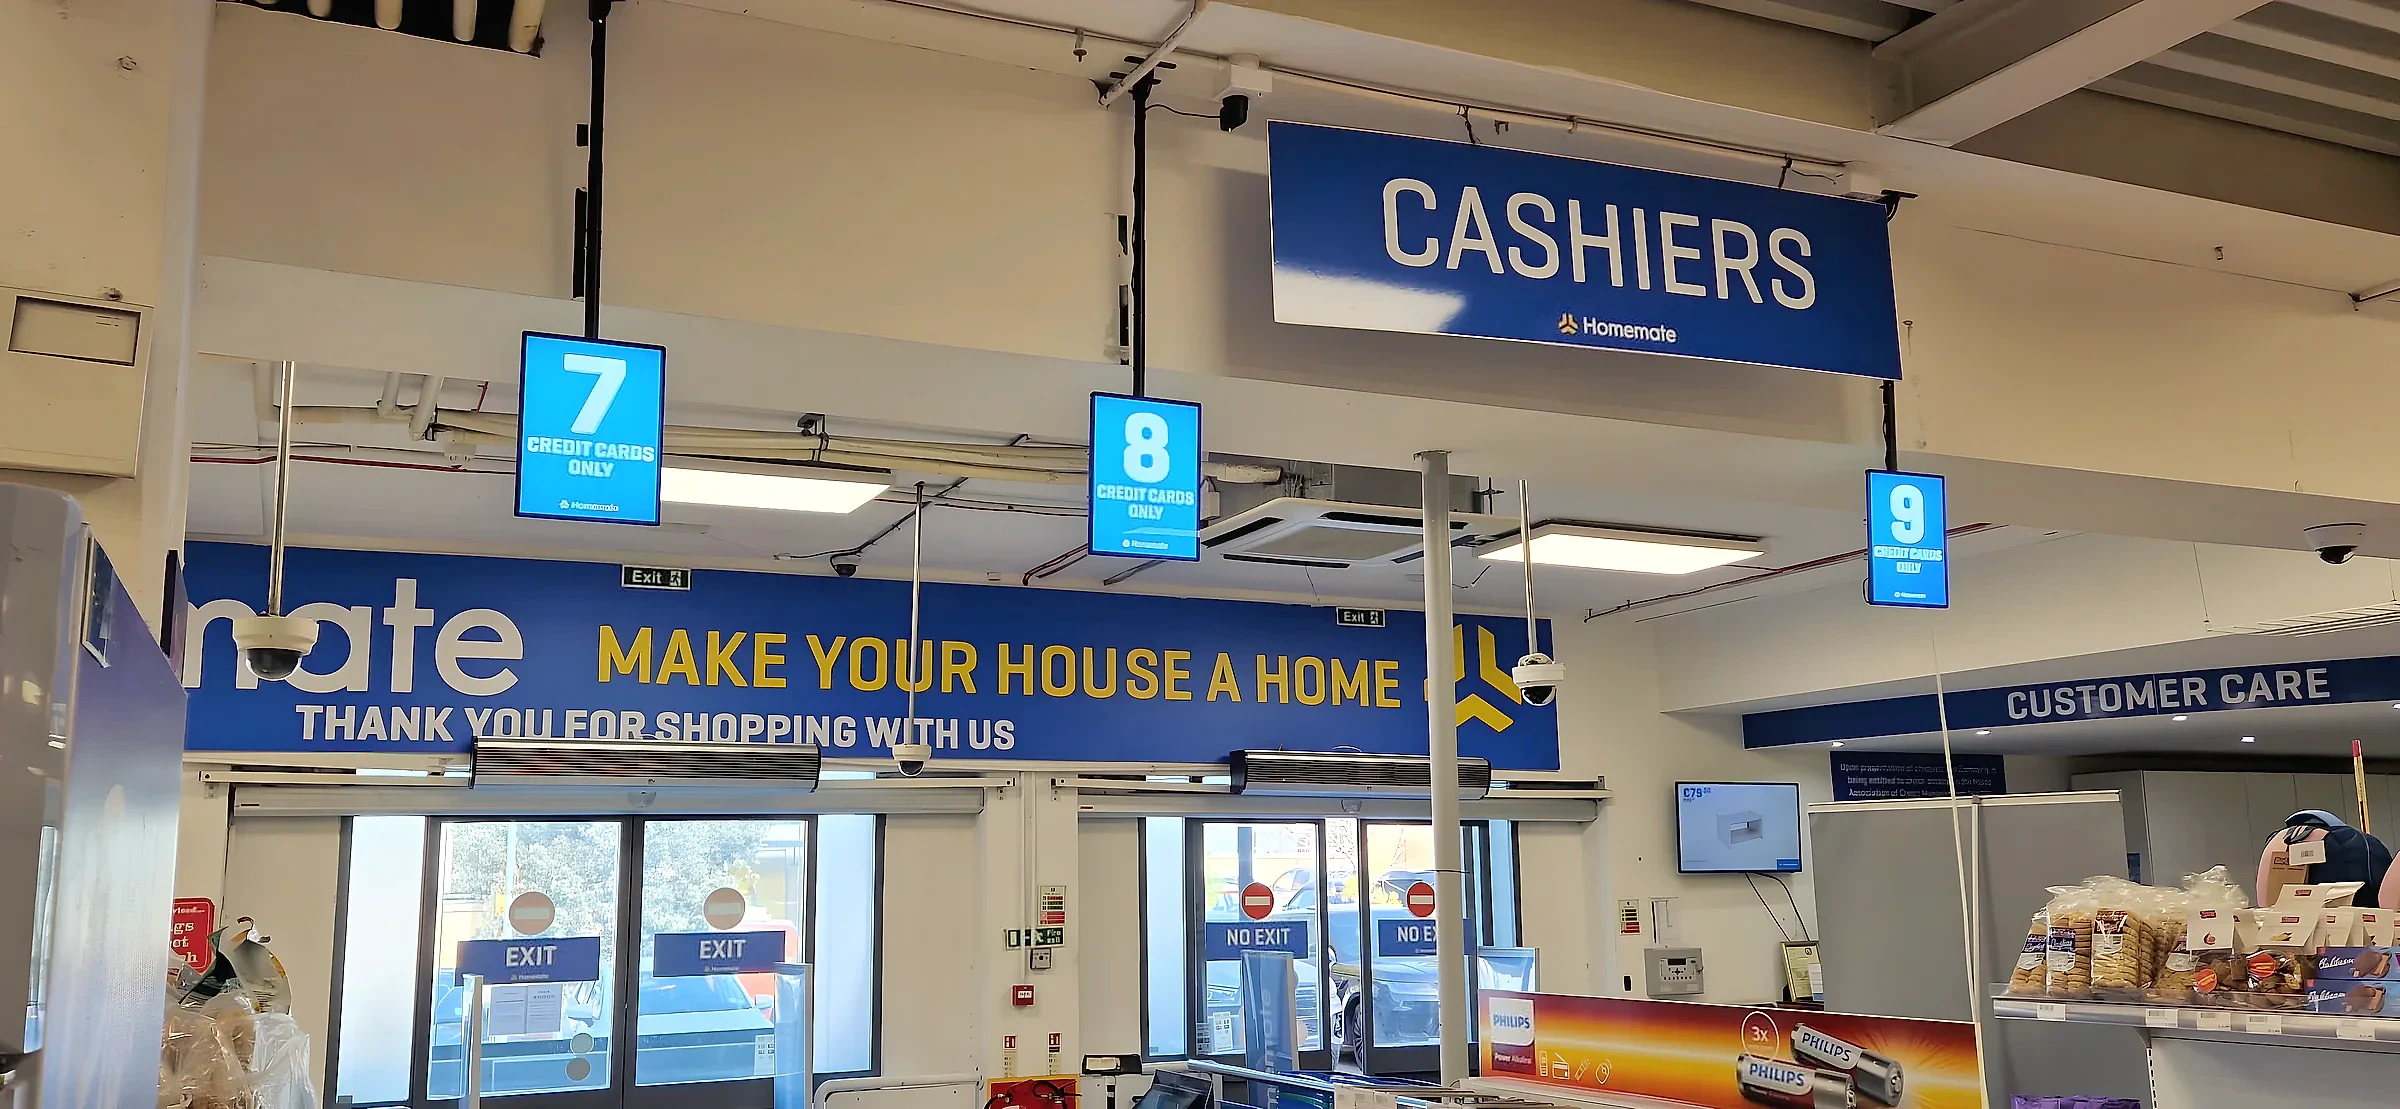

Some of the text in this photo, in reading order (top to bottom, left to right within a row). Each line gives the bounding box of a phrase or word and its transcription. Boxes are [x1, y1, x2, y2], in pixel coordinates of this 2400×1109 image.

[1381, 177, 1817, 310] CASHIERS
[1583, 315, 1677, 344] Homemate
[563, 353, 627, 435] 7
[527, 436, 655, 462] CREDIT CARDS
[1123, 412, 1170, 484] 8
[568, 459, 615, 479] ONLY
[1096, 484, 1195, 506] CREDIT CARDS
[1128, 503, 1164, 521] ONLY
[1889, 484, 1925, 545] 9
[632, 569, 662, 585] Exit
[598, 625, 1401, 708] MAKE YOUR HOUSE A HOME
[2007, 667, 2331, 720] CUSTOMER CARE
[296, 704, 1015, 751] THANK YOU FOR SHOPPING WITH US
[1227, 928, 1290, 946] NO EXIT
[1397, 926, 1419, 942] NO
[506, 945, 557, 967] EXIT
[700, 939, 746, 959] EXIT
[1493, 1012, 1531, 1029] PHILIPS
[1752, 1025, 1768, 1042] 3x
[1801, 1032, 1851, 1063] PHILIPS
[1749, 1062, 1805, 1087] PHILIPS
